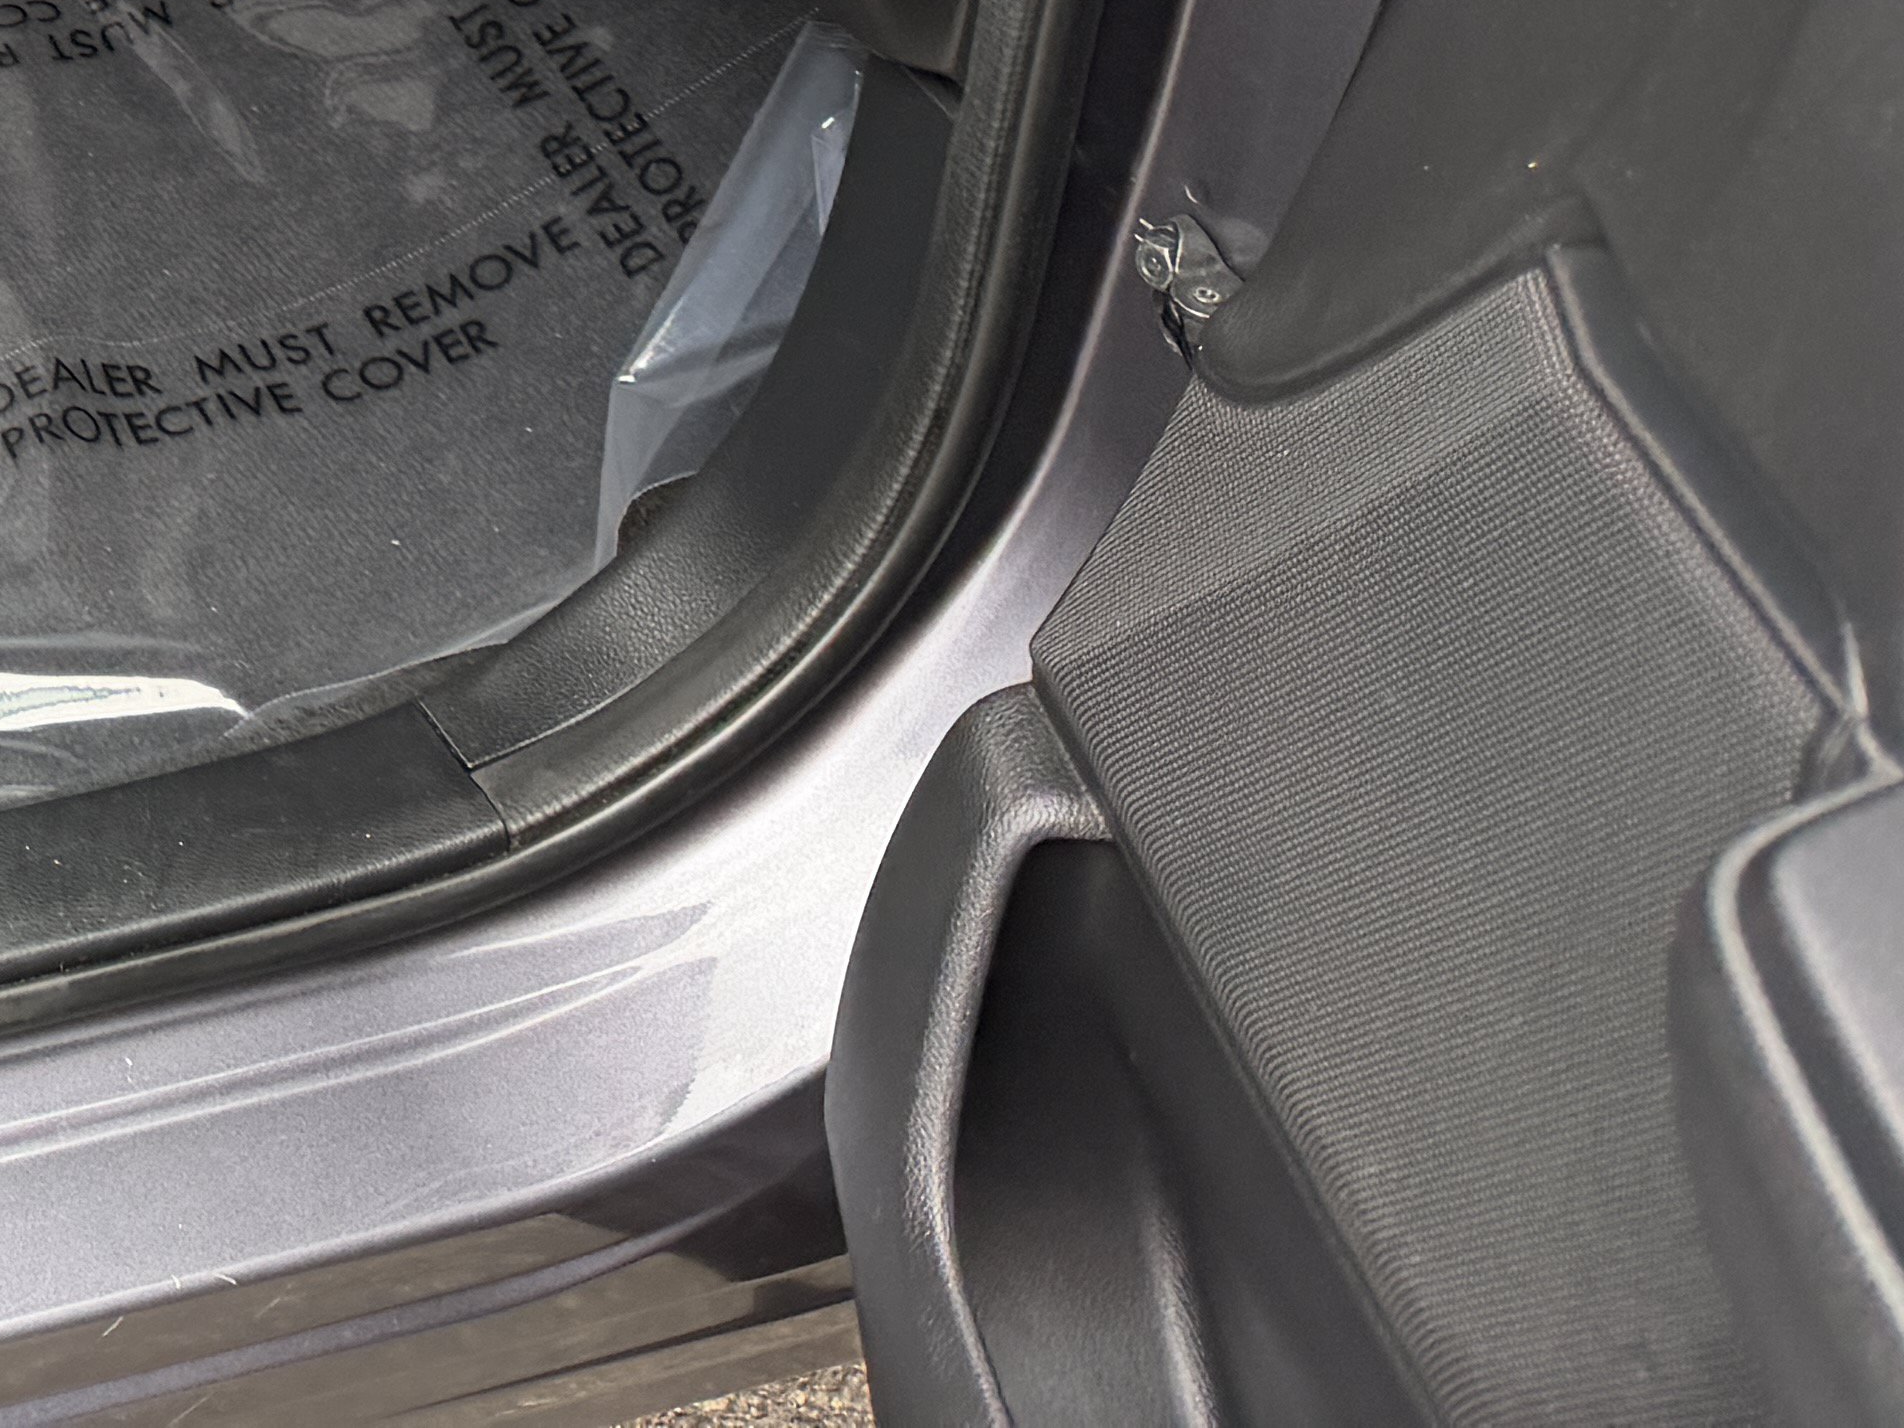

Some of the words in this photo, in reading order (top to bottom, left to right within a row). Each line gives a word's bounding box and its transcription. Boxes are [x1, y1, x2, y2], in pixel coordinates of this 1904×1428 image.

[49, 0, 173, 63] MUST
[448, 2, 552, 111] MUST
[540, 121, 666, 279] DEALER
[193, 321, 337, 385] MUST
[362, 216, 582, 339] REMOVE
[0, 381, 303, 461] PROTECTIVE
[320, 317, 500, 404] COVER
